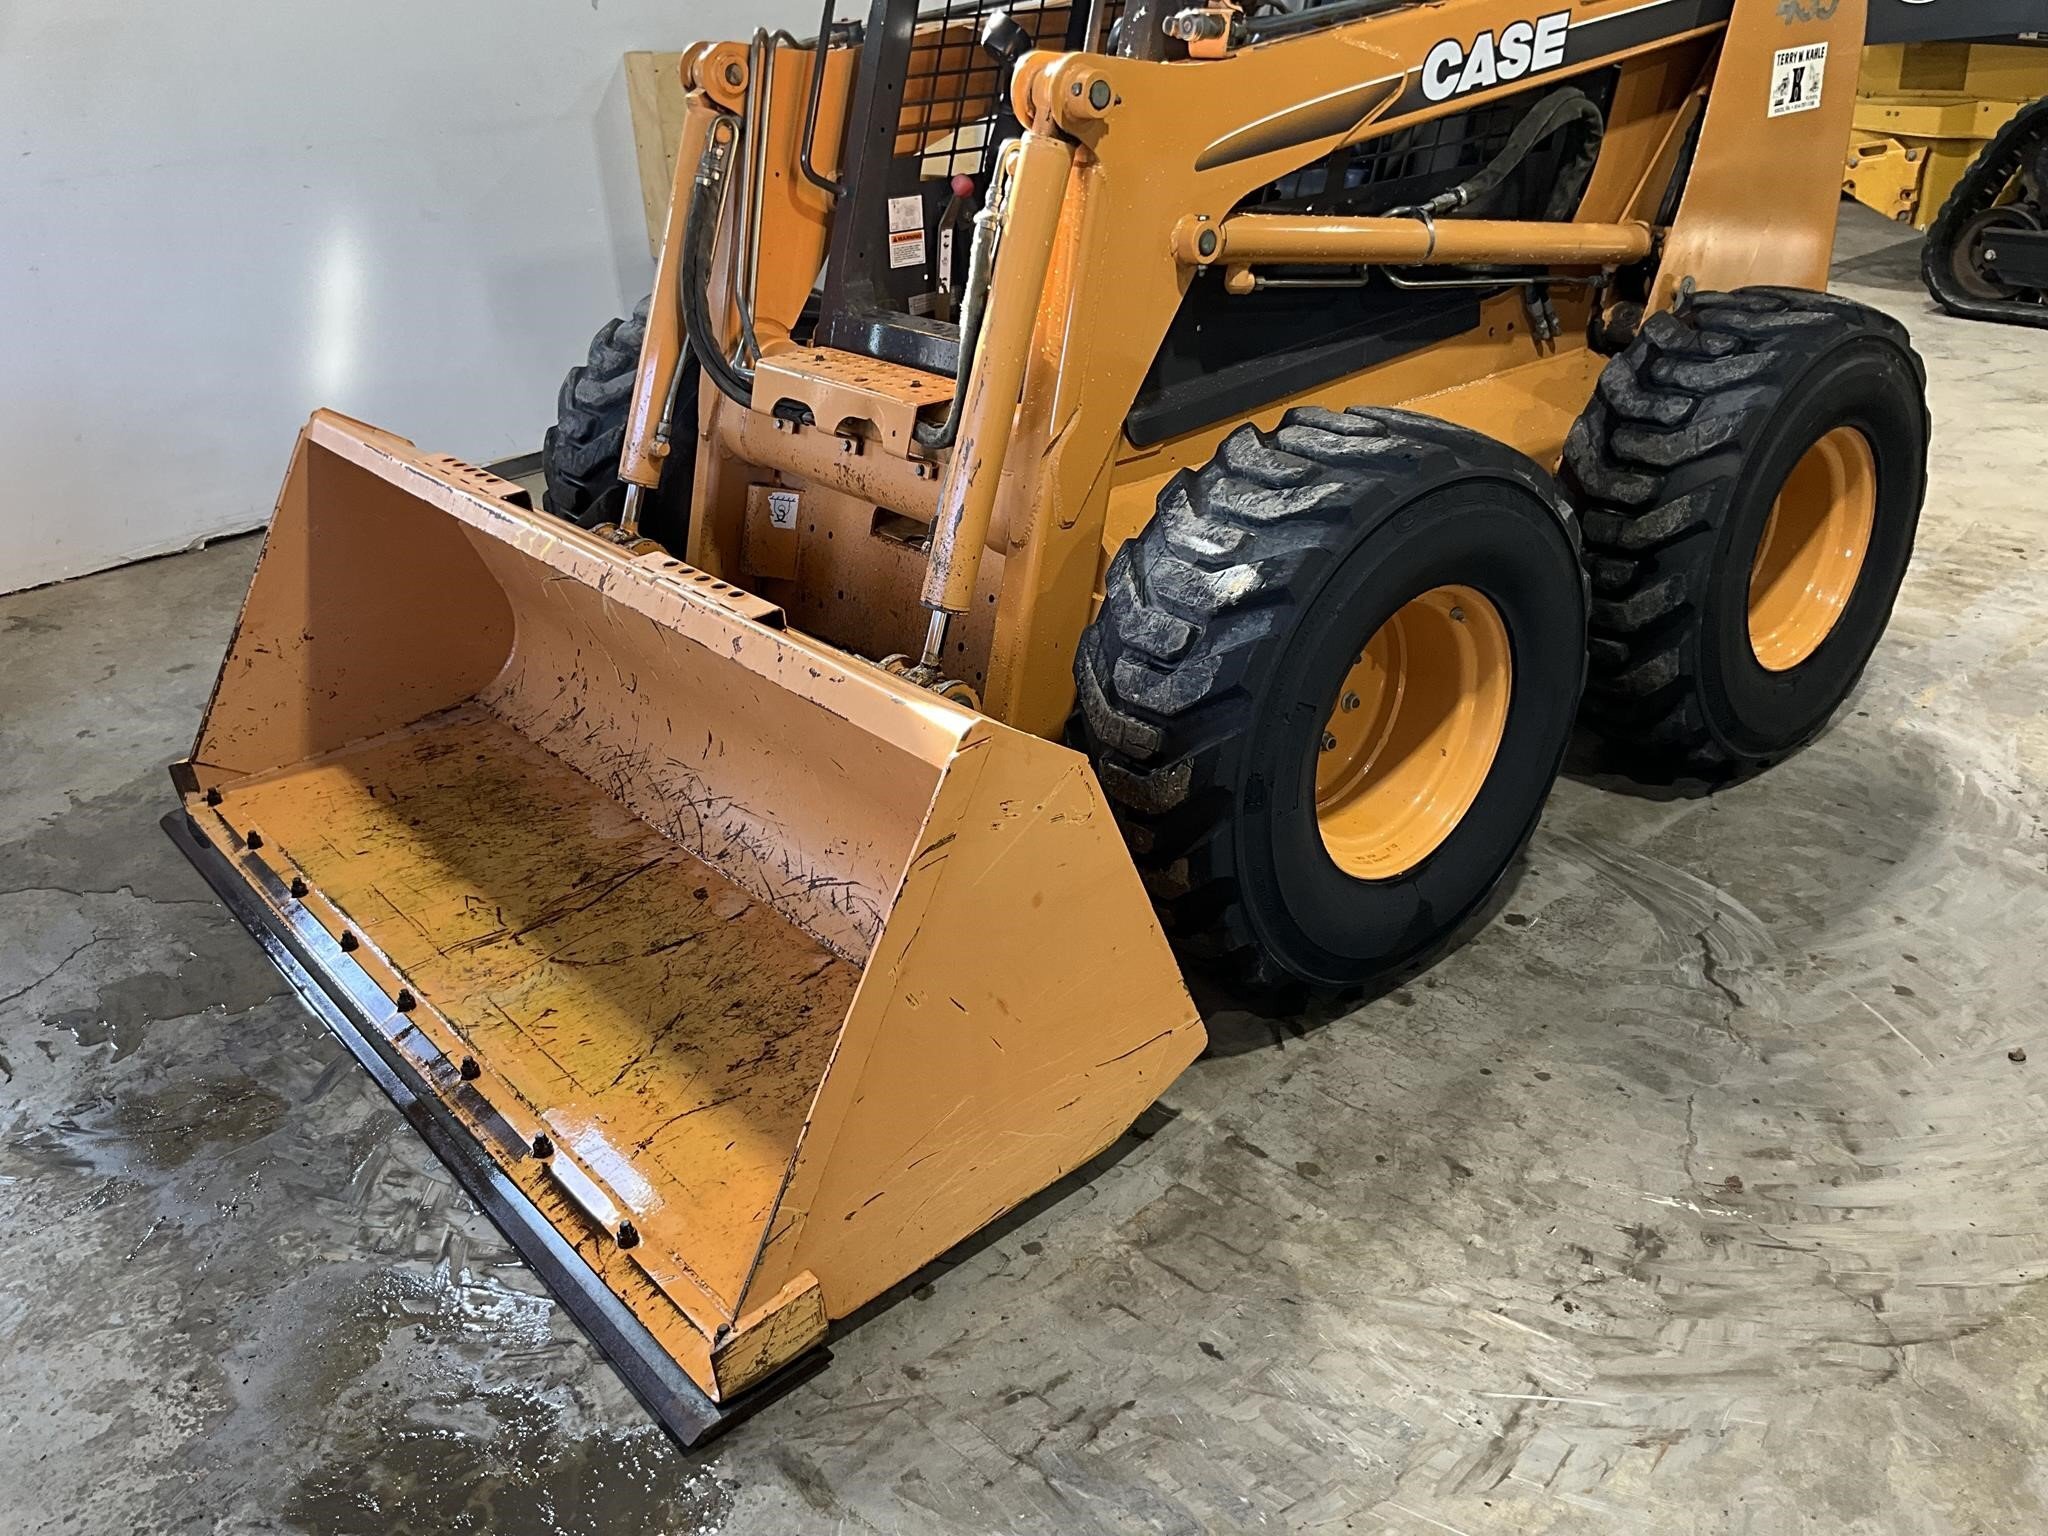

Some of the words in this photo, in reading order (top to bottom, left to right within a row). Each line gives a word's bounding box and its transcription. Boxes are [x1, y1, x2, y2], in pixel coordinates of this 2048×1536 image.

[1421, 10, 1571, 101] CASE
[1777, 52, 1798, 66] TERRY
[1806, 47, 1825, 60] KAHLE
[898, 232, 922, 241] WARNING
